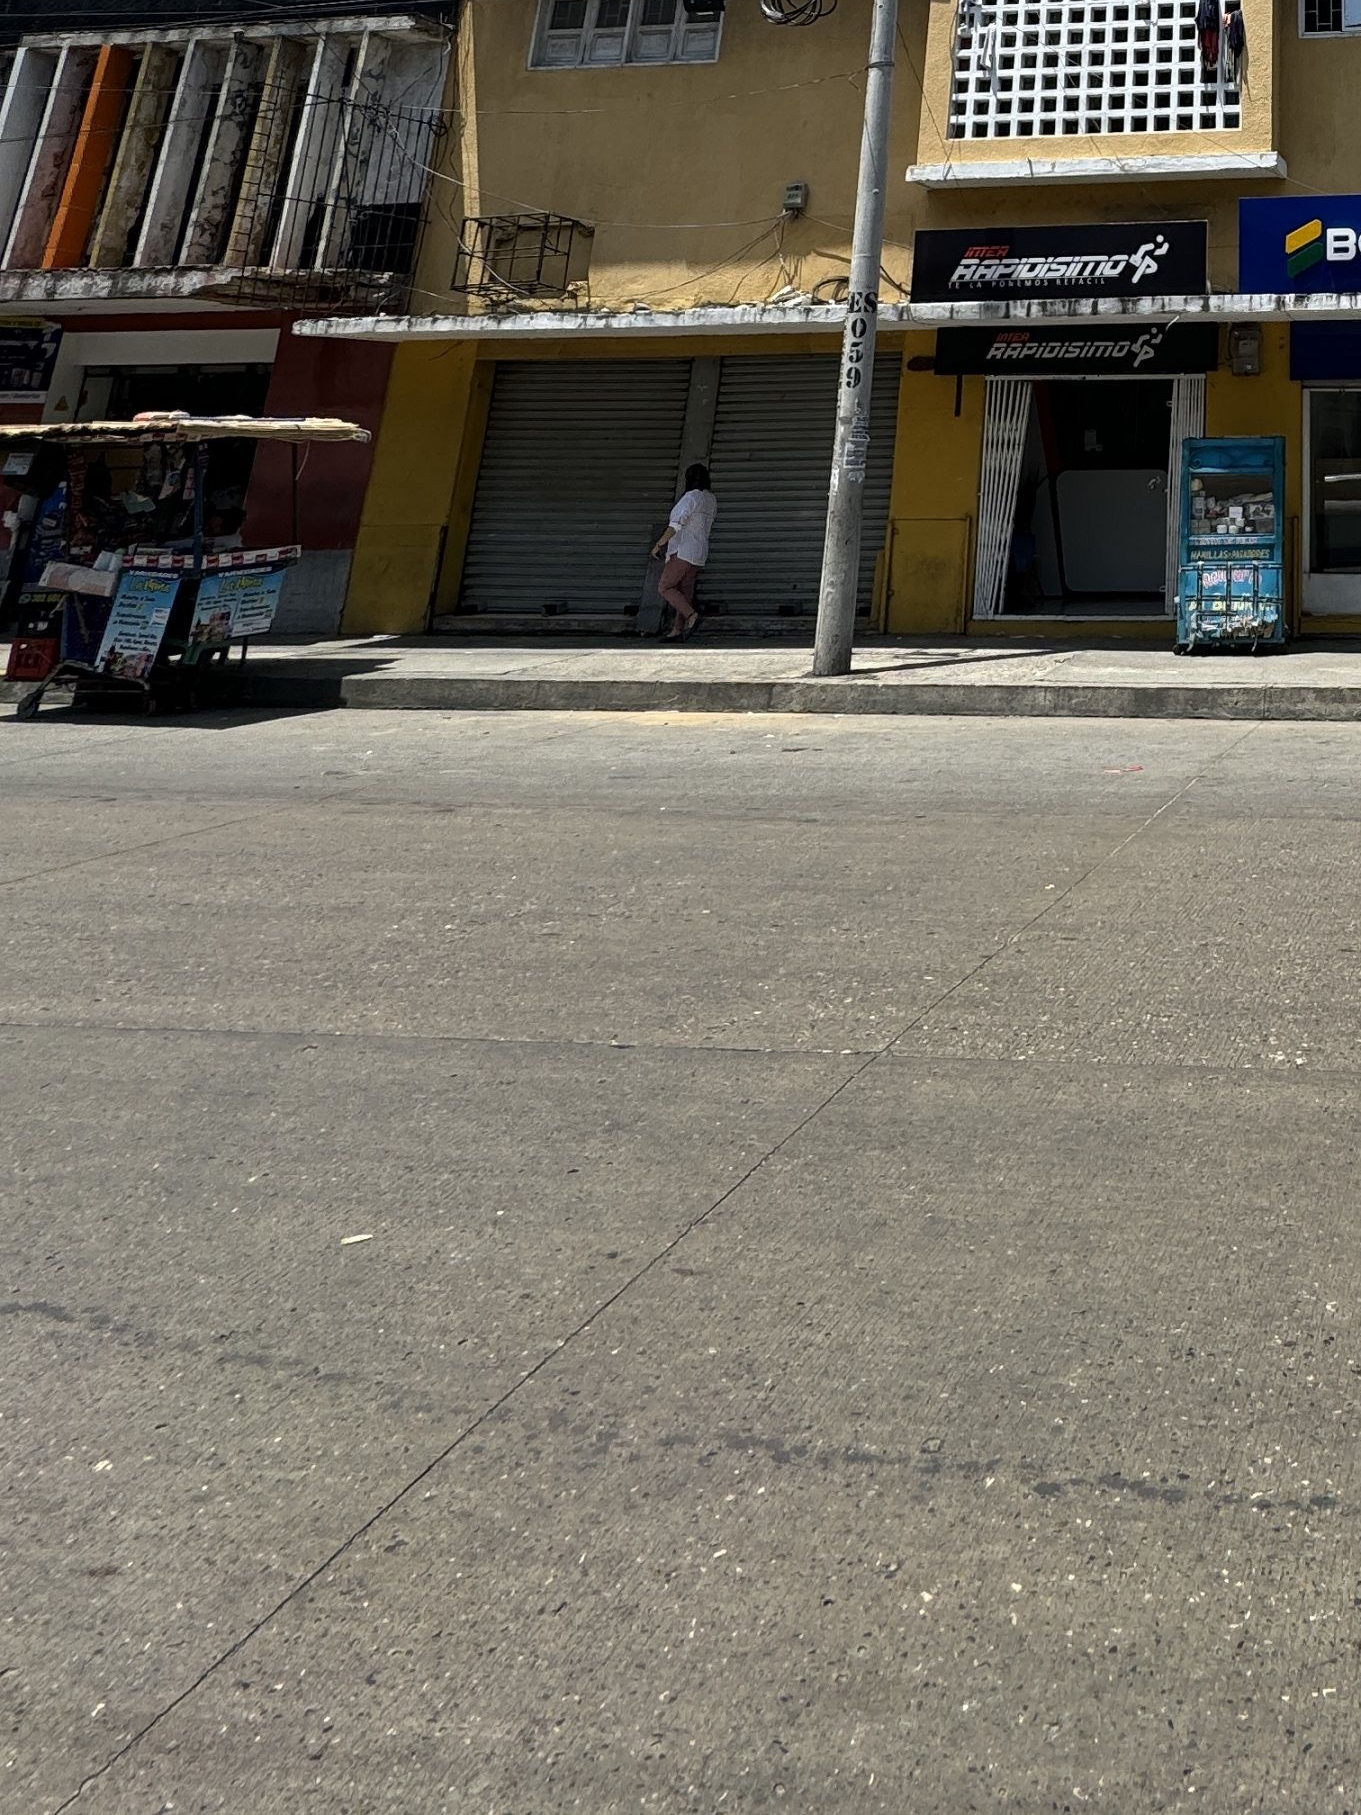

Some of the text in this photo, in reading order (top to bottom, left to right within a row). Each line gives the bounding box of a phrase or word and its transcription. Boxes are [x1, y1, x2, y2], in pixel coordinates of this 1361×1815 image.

[962, 245, 1010, 258] INTER
[991, 279, 1049, 288] PONEMOS
[849, 291, 877, 314] ES
[995, 331, 1031, 343] INTER
